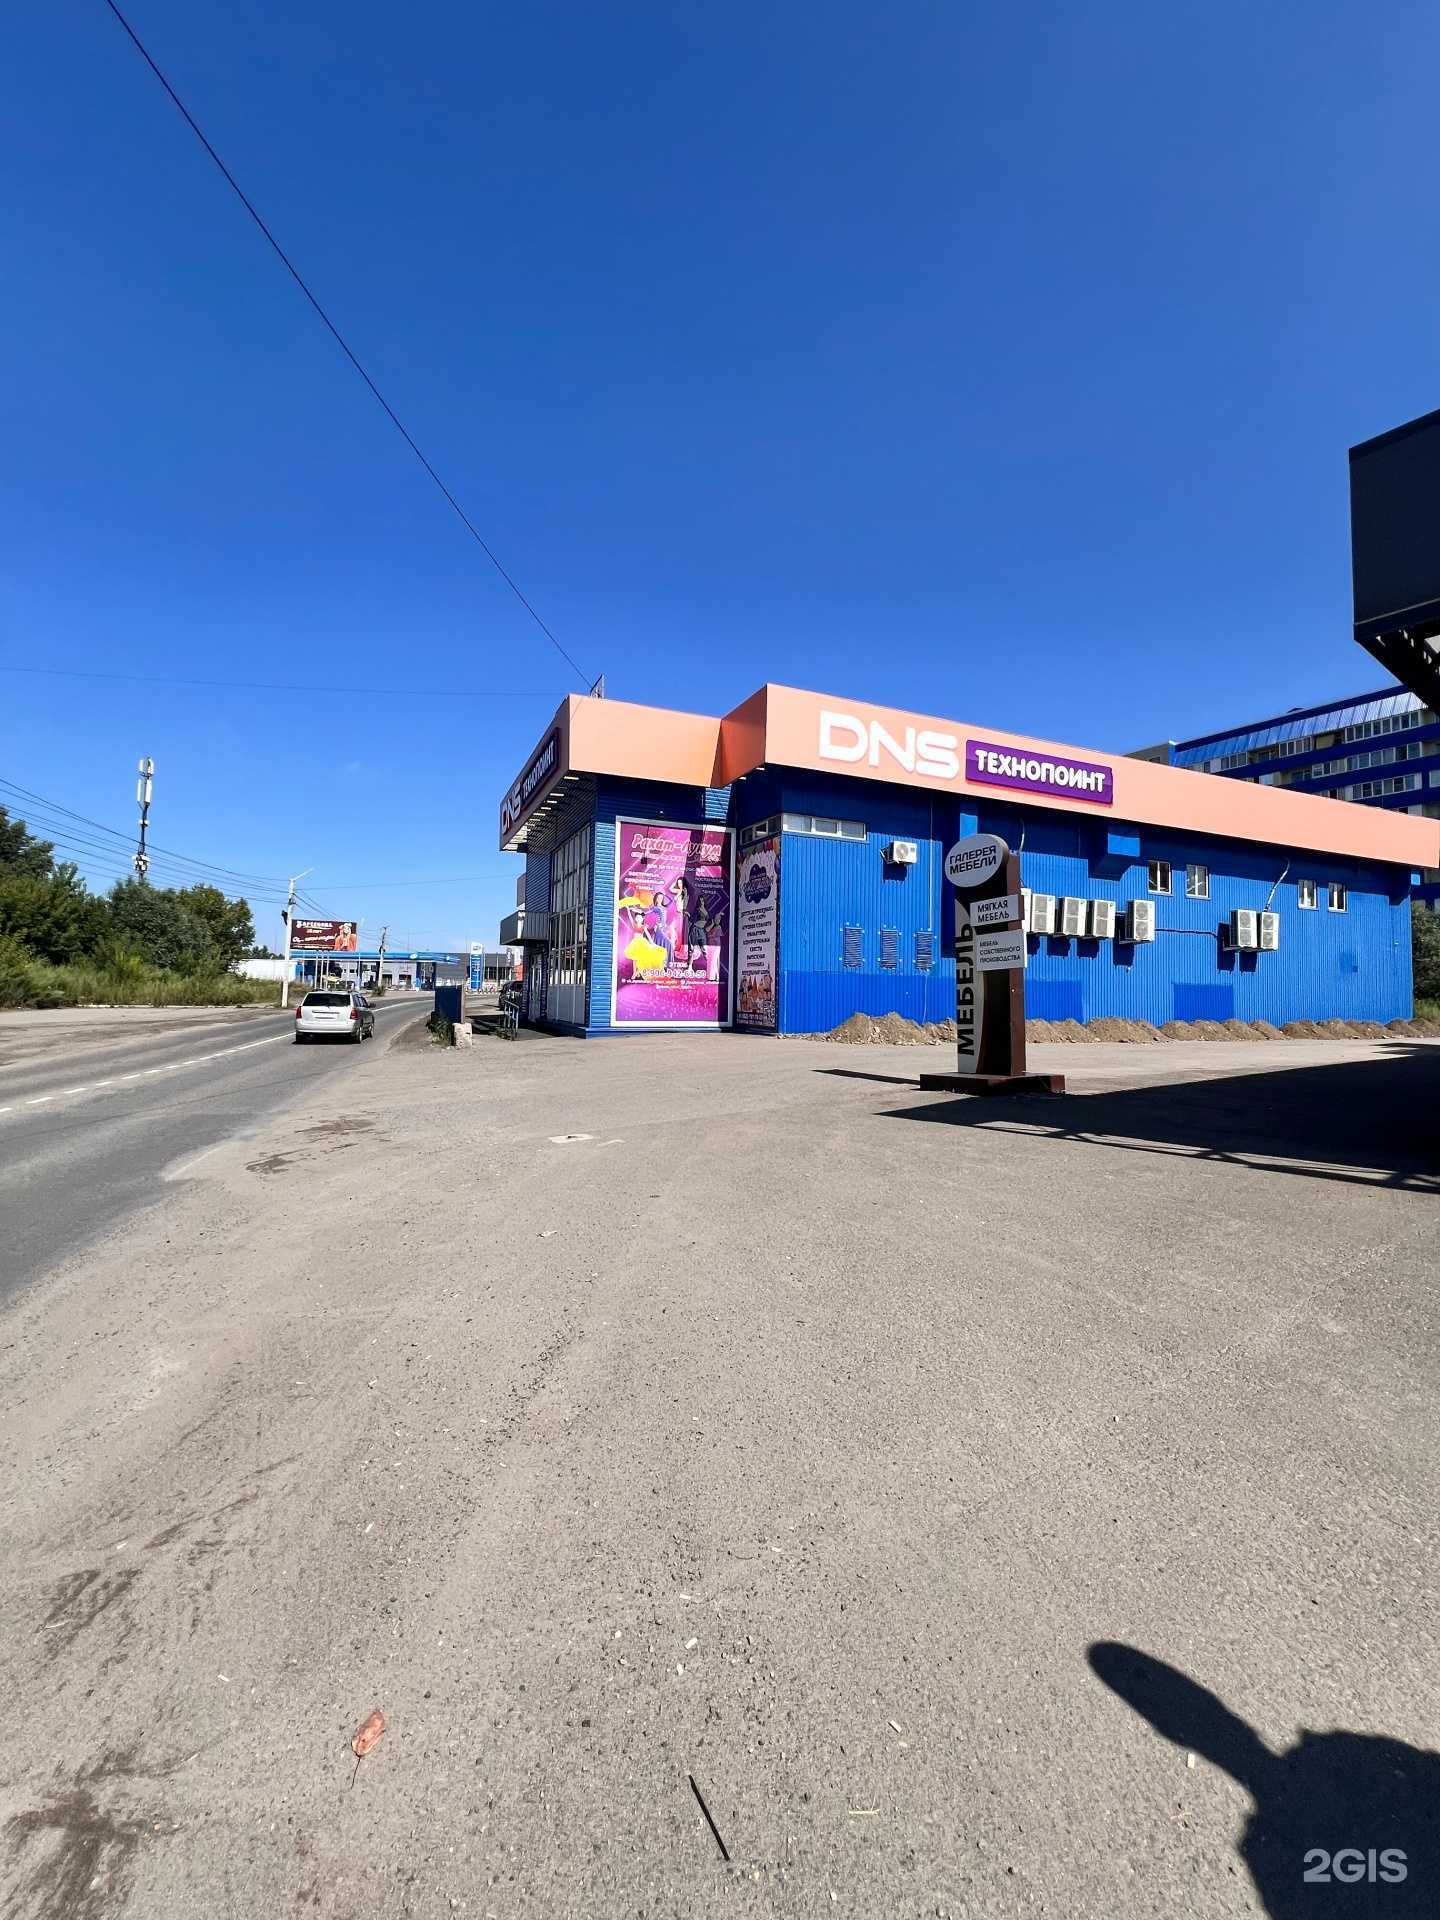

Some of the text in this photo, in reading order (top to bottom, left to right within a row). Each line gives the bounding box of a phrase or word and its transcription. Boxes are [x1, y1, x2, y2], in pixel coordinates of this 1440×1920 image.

[818, 710, 959, 779] DNS
[975, 749, 1106, 793] ТЕХНОПОИНТ
[501, 782, 522, 834] DNS
[949, 844, 997, 865] ГАЛЕРЕЯ
[949, 855, 997, 876] МЕБЕЛИ
[977, 899, 1009, 913] МЯГКАЯ
[977, 910, 1010, 923] МЕБЕЛЬ
[955, 922, 975, 1057] МЕБЕЛЬ
